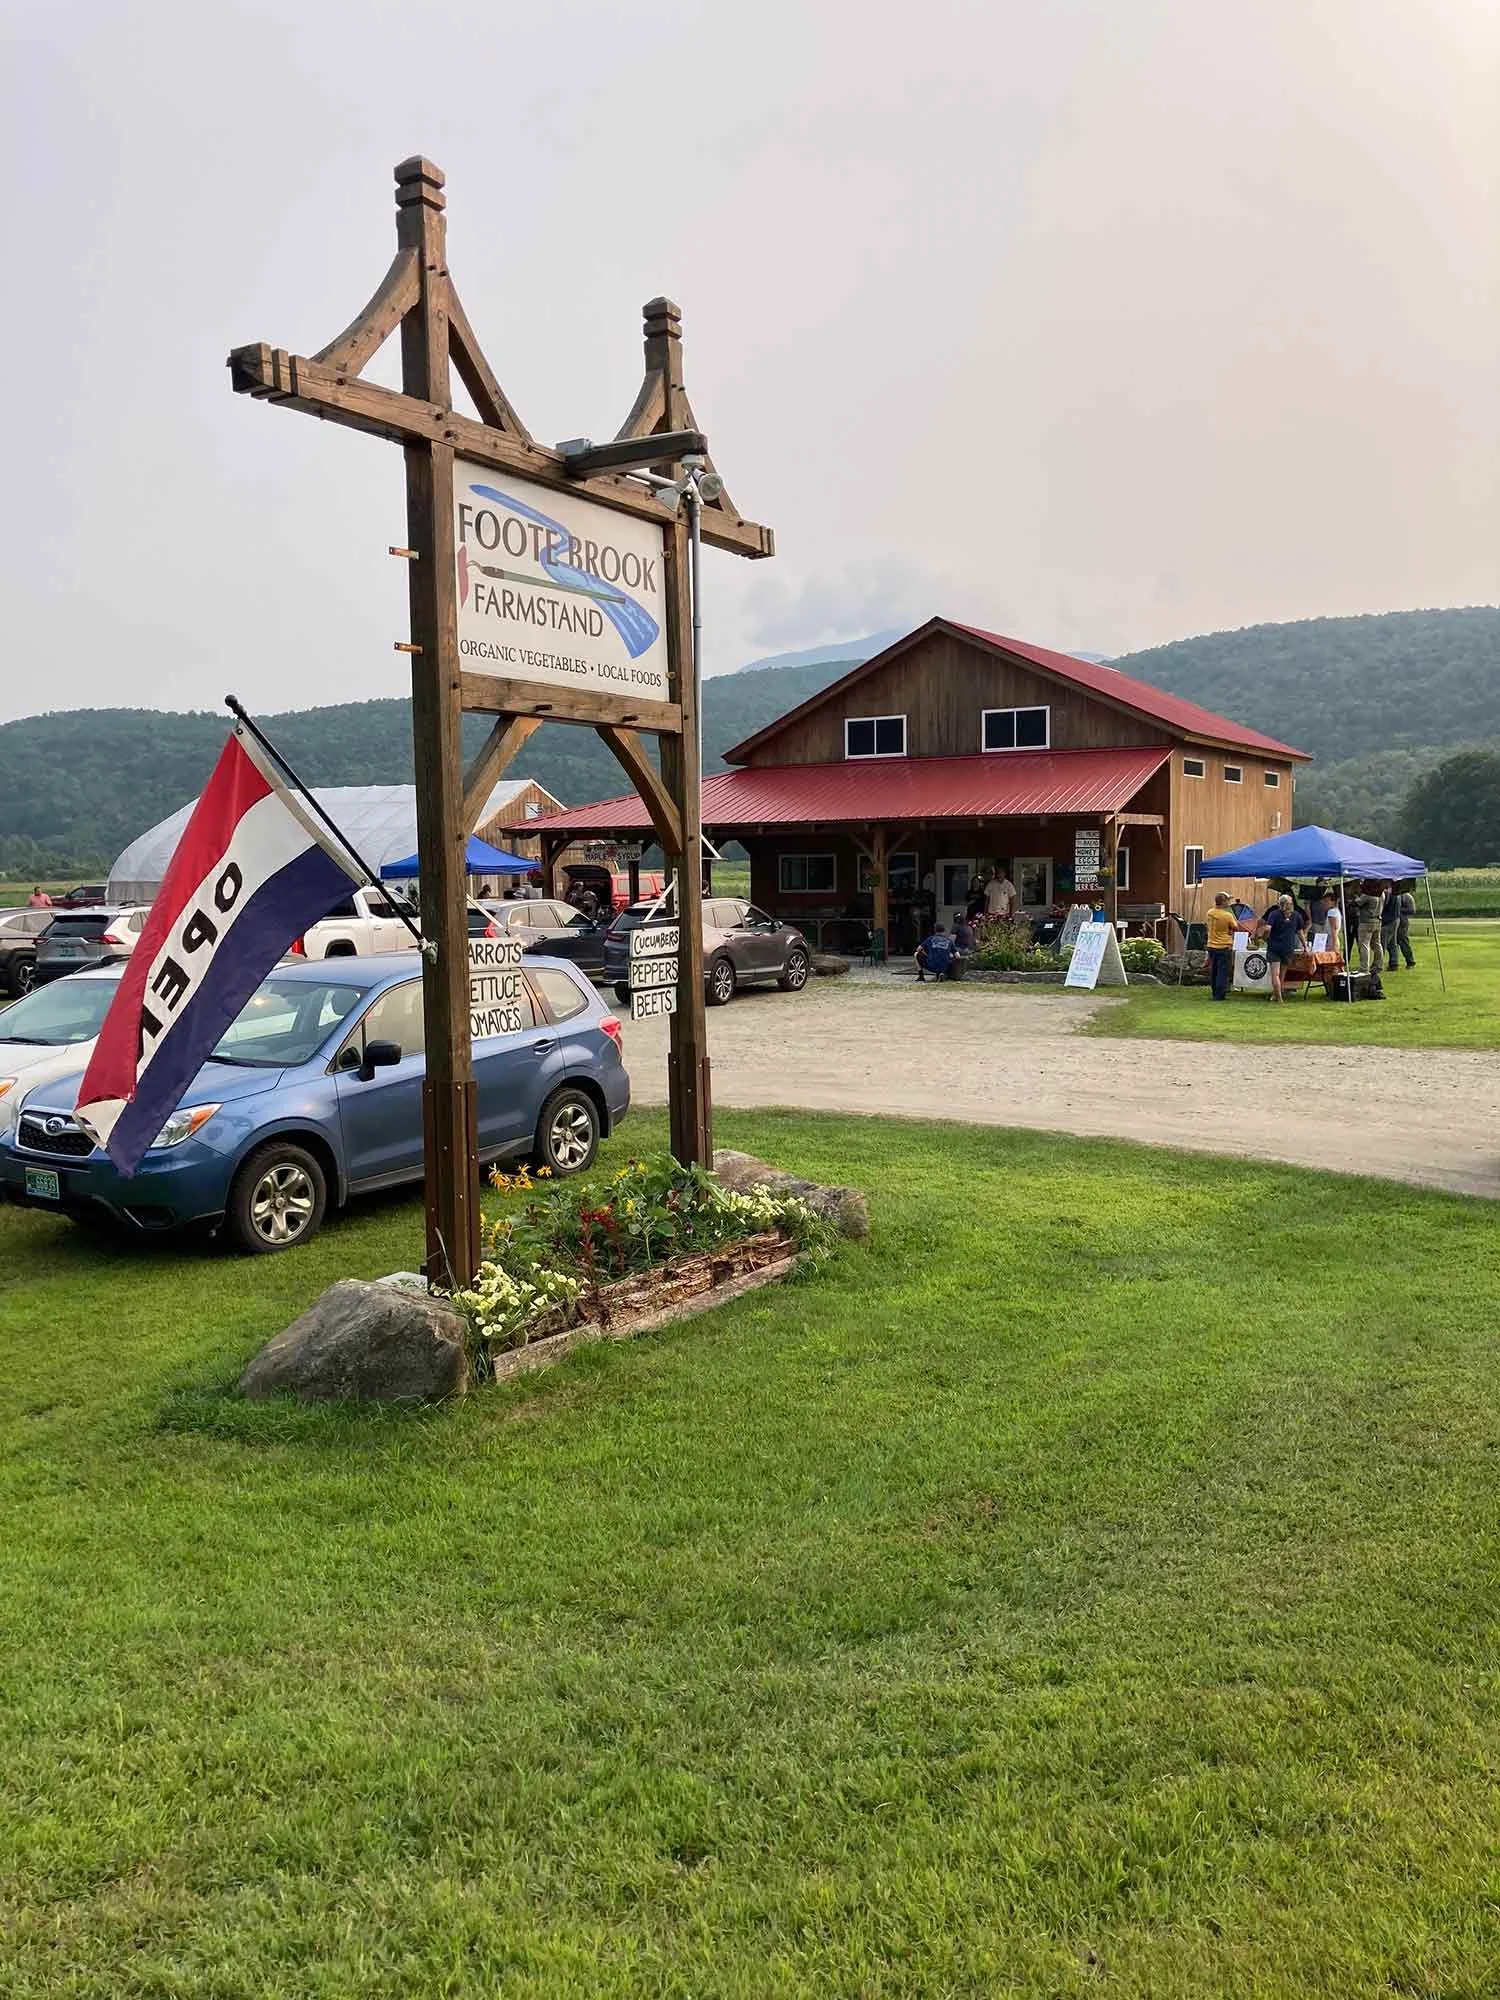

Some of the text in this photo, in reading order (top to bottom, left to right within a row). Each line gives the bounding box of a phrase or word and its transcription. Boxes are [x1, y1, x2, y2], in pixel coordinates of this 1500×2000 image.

[457, 503, 657, 593] FOOTE BROOK
[474, 583, 604, 637] FARMSTAND
[460, 639, 662, 687] ORGANIC VEGETABLES LOCAL FOODS
[1078, 857, 1096, 865] EGGS
[469, 942, 522, 965] ARROTS
[634, 931, 679, 954] CUCUMBERS
[632, 960, 679, 984] PEPPERS
[470, 975, 521, 1001] ETTUCE
[637, 990, 672, 1017] BEETS
[470, 1007, 522, 1036] OMATOES
